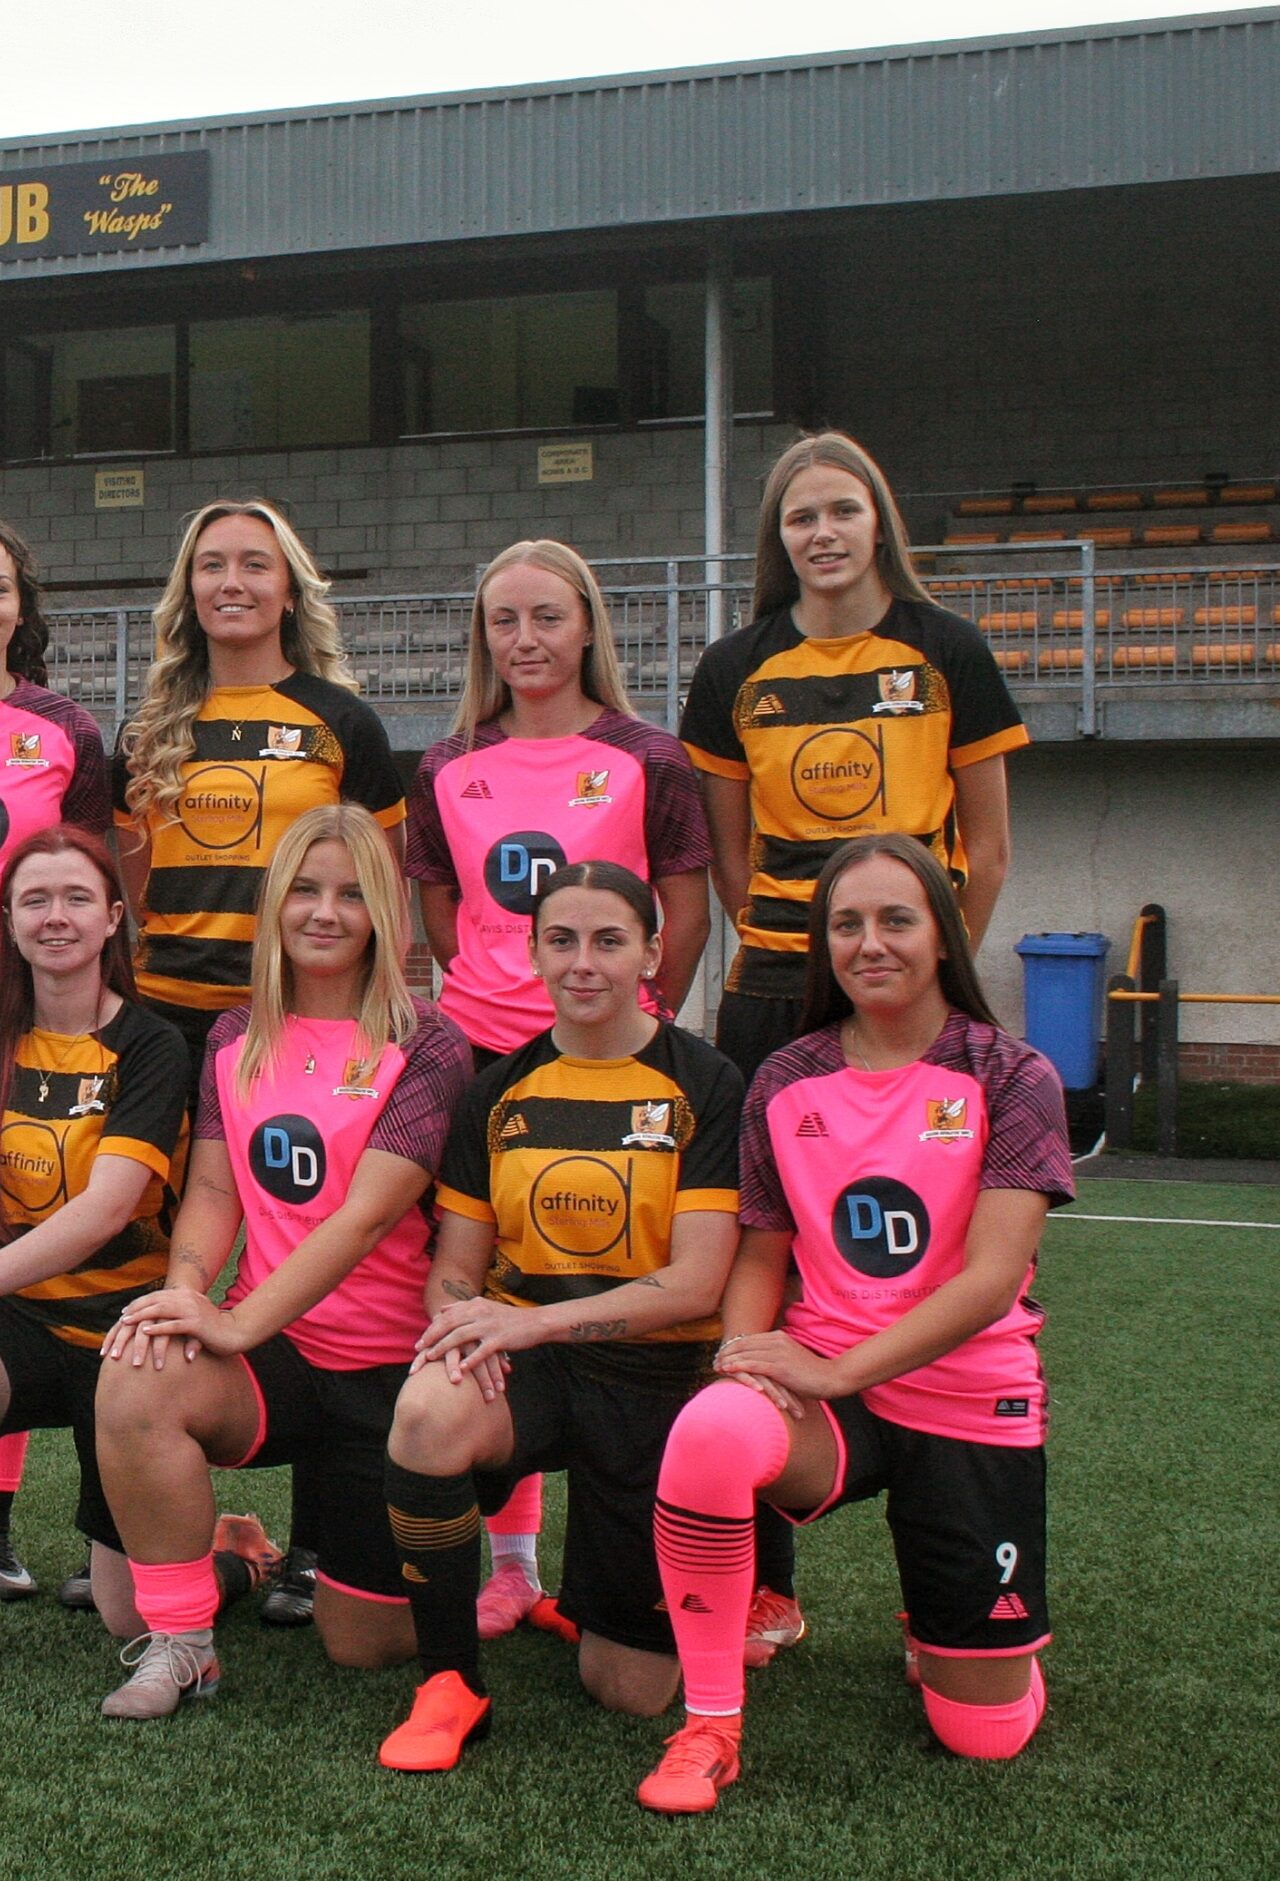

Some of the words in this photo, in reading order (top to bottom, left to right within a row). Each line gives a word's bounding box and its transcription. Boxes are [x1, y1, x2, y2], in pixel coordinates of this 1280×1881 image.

[98, 488, 141, 500] DIRECTORS
[801, 761, 873, 781] affinity
[185, 793, 253, 813] affinity
[0, 1150, 55, 1177] affinity
[540, 1191, 620, 1217] affinity
[995, 1542, 1018, 1584] 9
